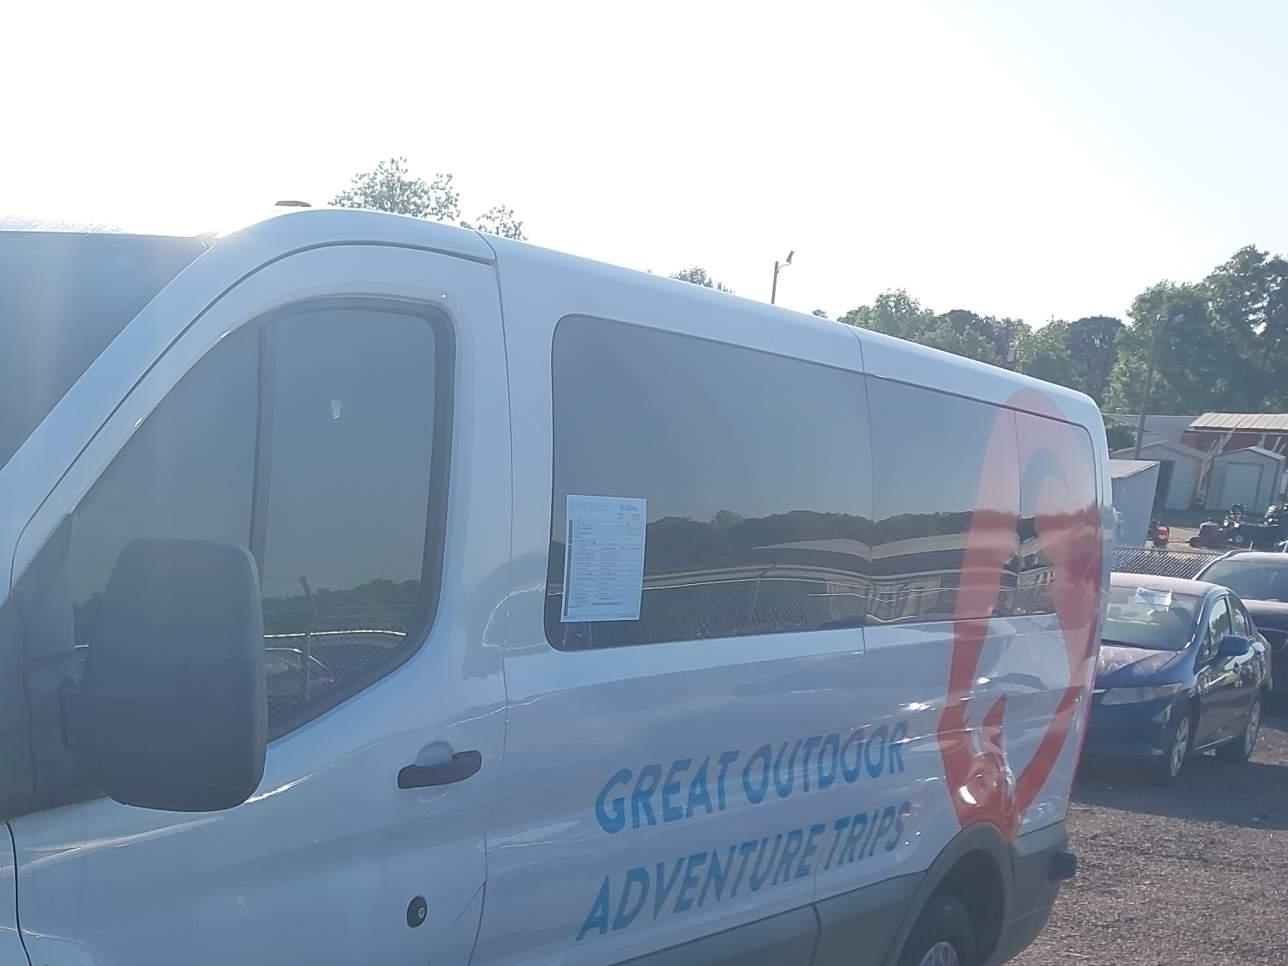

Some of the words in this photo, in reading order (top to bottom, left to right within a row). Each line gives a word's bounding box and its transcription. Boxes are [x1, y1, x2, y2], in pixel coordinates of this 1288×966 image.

[595, 749, 741, 834] GREAT
[742, 721, 909, 804] OUTDOOR
[576, 822, 826, 942] ADVENTURE
[823, 800, 912, 871] TRIPS
